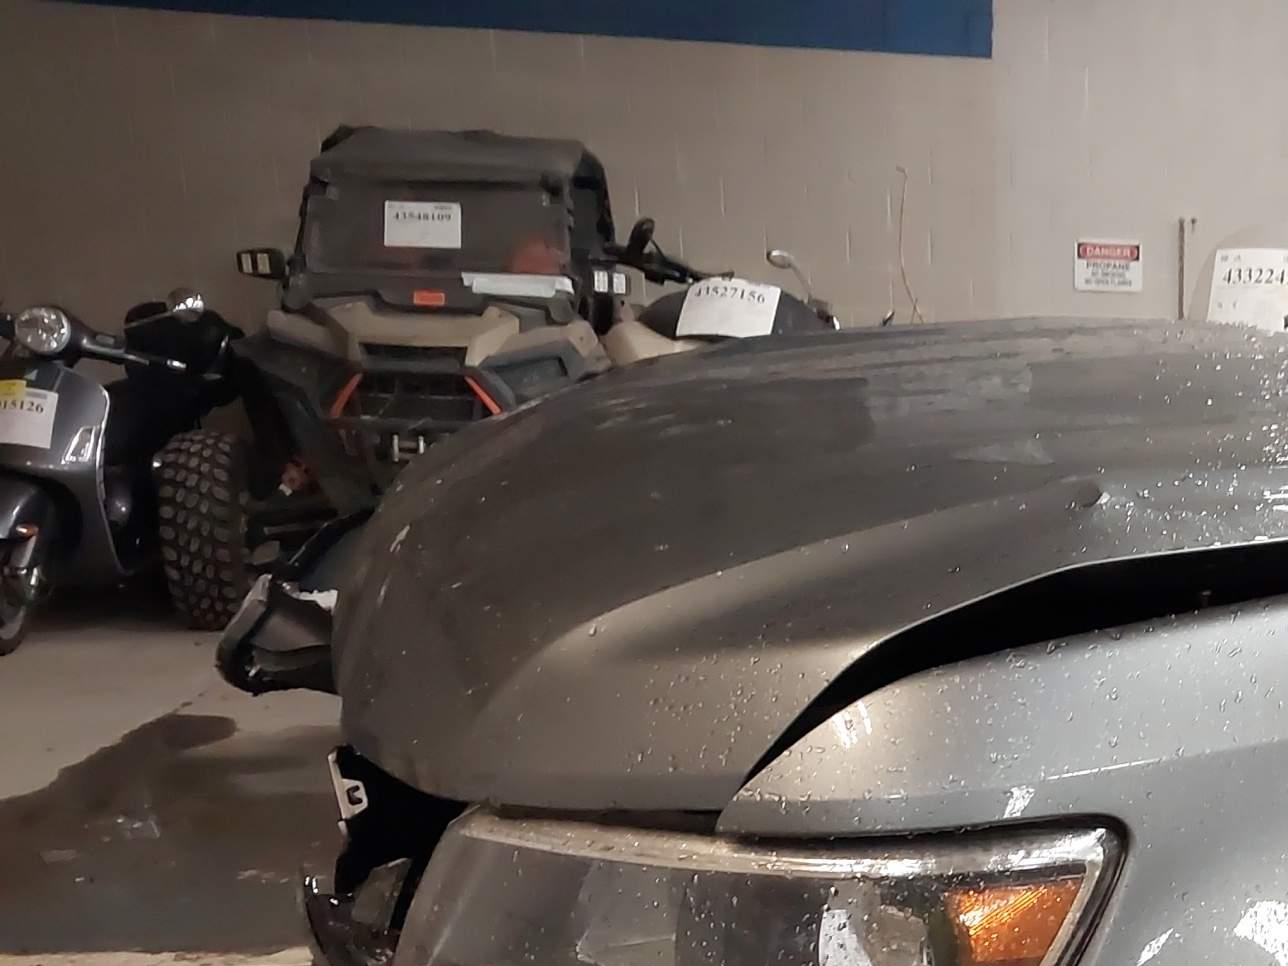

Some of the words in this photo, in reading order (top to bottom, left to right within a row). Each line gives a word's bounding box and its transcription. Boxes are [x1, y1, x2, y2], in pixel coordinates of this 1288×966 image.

[1086, 246, 1131, 258] DANGER
[1086, 262, 1130, 271] PROPANE
[0, 399, 44, 413] 15126
